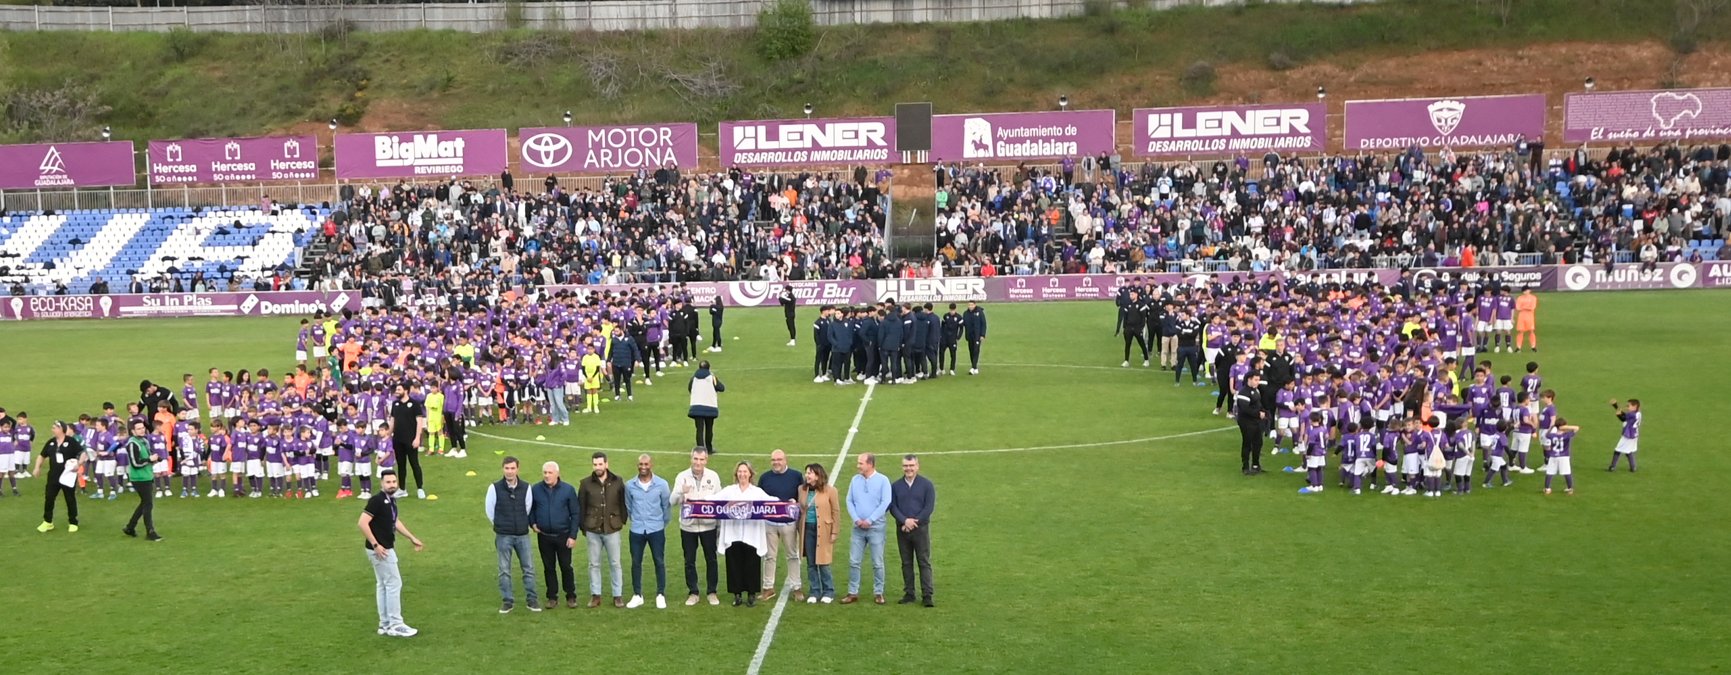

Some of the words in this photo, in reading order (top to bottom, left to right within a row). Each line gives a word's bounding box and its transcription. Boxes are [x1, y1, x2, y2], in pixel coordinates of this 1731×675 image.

[1173, 108, 1311, 138] LENER
[588, 127, 673, 149] MOTOR
[757, 122, 888, 149] LENER
[997, 125, 1063, 140] Ayuntamiento
[1065, 124, 1077, 136] de
[1590, 127, 1604, 140] El
[1607, 128, 1639, 139] sueño
[1642, 125, 1656, 138] de
[1660, 129, 1682, 137] una
[374, 133, 465, 166] BigMat
[996, 139, 1077, 157] Guadalajara
[1148, 139, 1226, 152] DESARROLLOS
[1229, 135, 1311, 150] INMOBILIARIOS
[1360, 136, 1430, 148] DEPORTIVO
[584, 147, 678, 169] ARJONA
[734, 151, 807, 164] DESARROLLOS
[810, 148, 888, 162] INMOBILIARIOS
[153, 163, 197, 173] Hercesa
[211, 161, 256, 172] Hercesa
[270, 159, 315, 170] Hercesa
[414, 165, 464, 174] REVIRIEGO
[34, 178, 75, 186] GUADALAJARA
[213, 173, 224, 181] 50
[1501, 271, 1542, 283] Seguros
[768, 284, 821, 299] Rmos
[822, 282, 857, 298] Bus
[900, 278, 987, 295] LENER
[142, 295, 157, 307] Su
[164, 295, 180, 306] In
[183, 294, 212, 306] Plas
[260, 299, 327, 314] Domino's
[1527, 378, 1538, 392] 21
[1359, 433, 1371, 452] 12
[1552, 436, 1564, 452] 21
[701, 505, 714, 514] CD
[716, 505, 777, 514] GUADALAJARA
